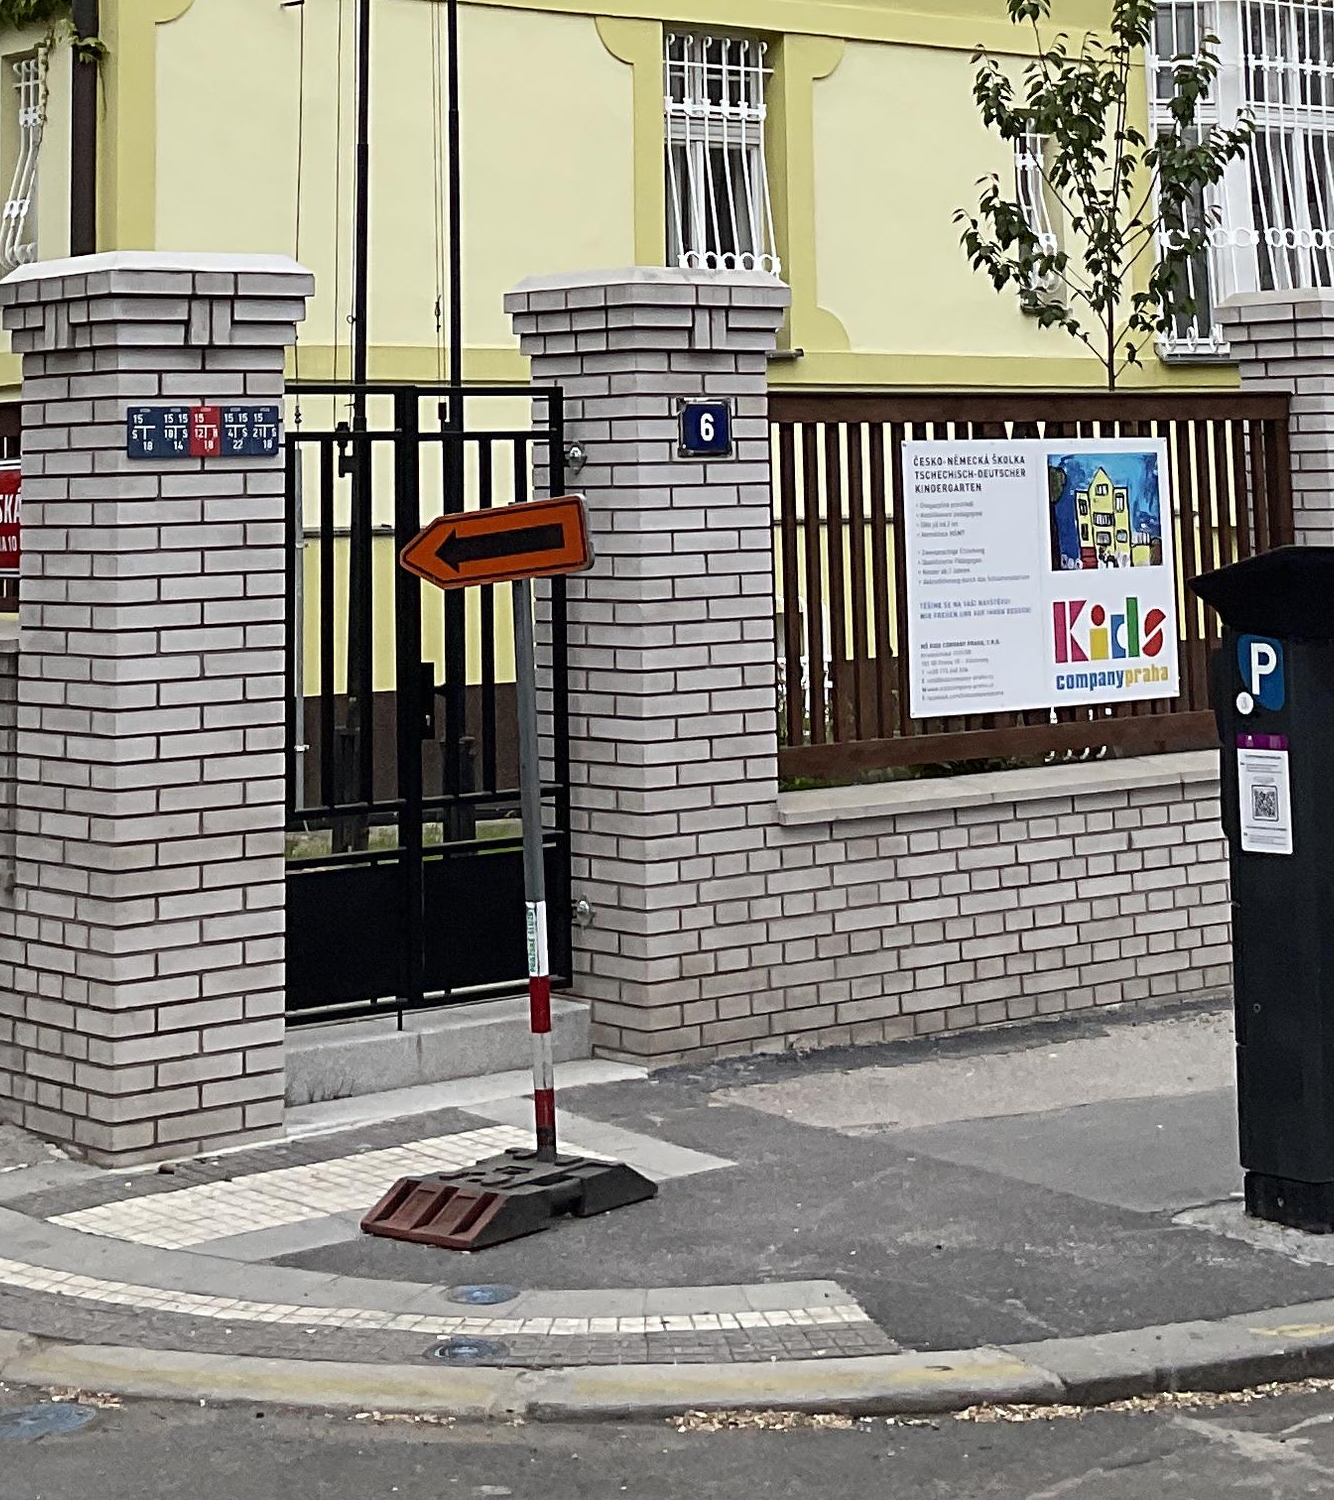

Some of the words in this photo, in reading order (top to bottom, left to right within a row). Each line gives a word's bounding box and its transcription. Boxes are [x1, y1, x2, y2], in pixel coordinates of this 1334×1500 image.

[133, 414, 144, 424] 15
[164, 413, 174, 424] 15
[178, 413, 188, 424] 15
[194, 413, 205, 423] 15
[224, 412, 234, 423] 15
[238, 412, 248, 423] 15
[253, 412, 263, 423] 15
[700, 412, 715, 442] 6
[194, 428, 204, 438] 12
[228, 428, 234, 438] 4
[232, 440, 243, 450] 22
[913, 454, 990, 467] ČESKO-NĚMECKÁ
[991, 452, 1026, 465] ŠKOLKA
[914, 467, 1026, 481] TSCHECHISCH-DEUTSCHER
[914, 482, 982, 494] KINDERGARTEN
[8, 535, 18, 552] 10
[1053, 596, 1167, 664] Kids
[1056, 663, 1169, 692] companypraha
